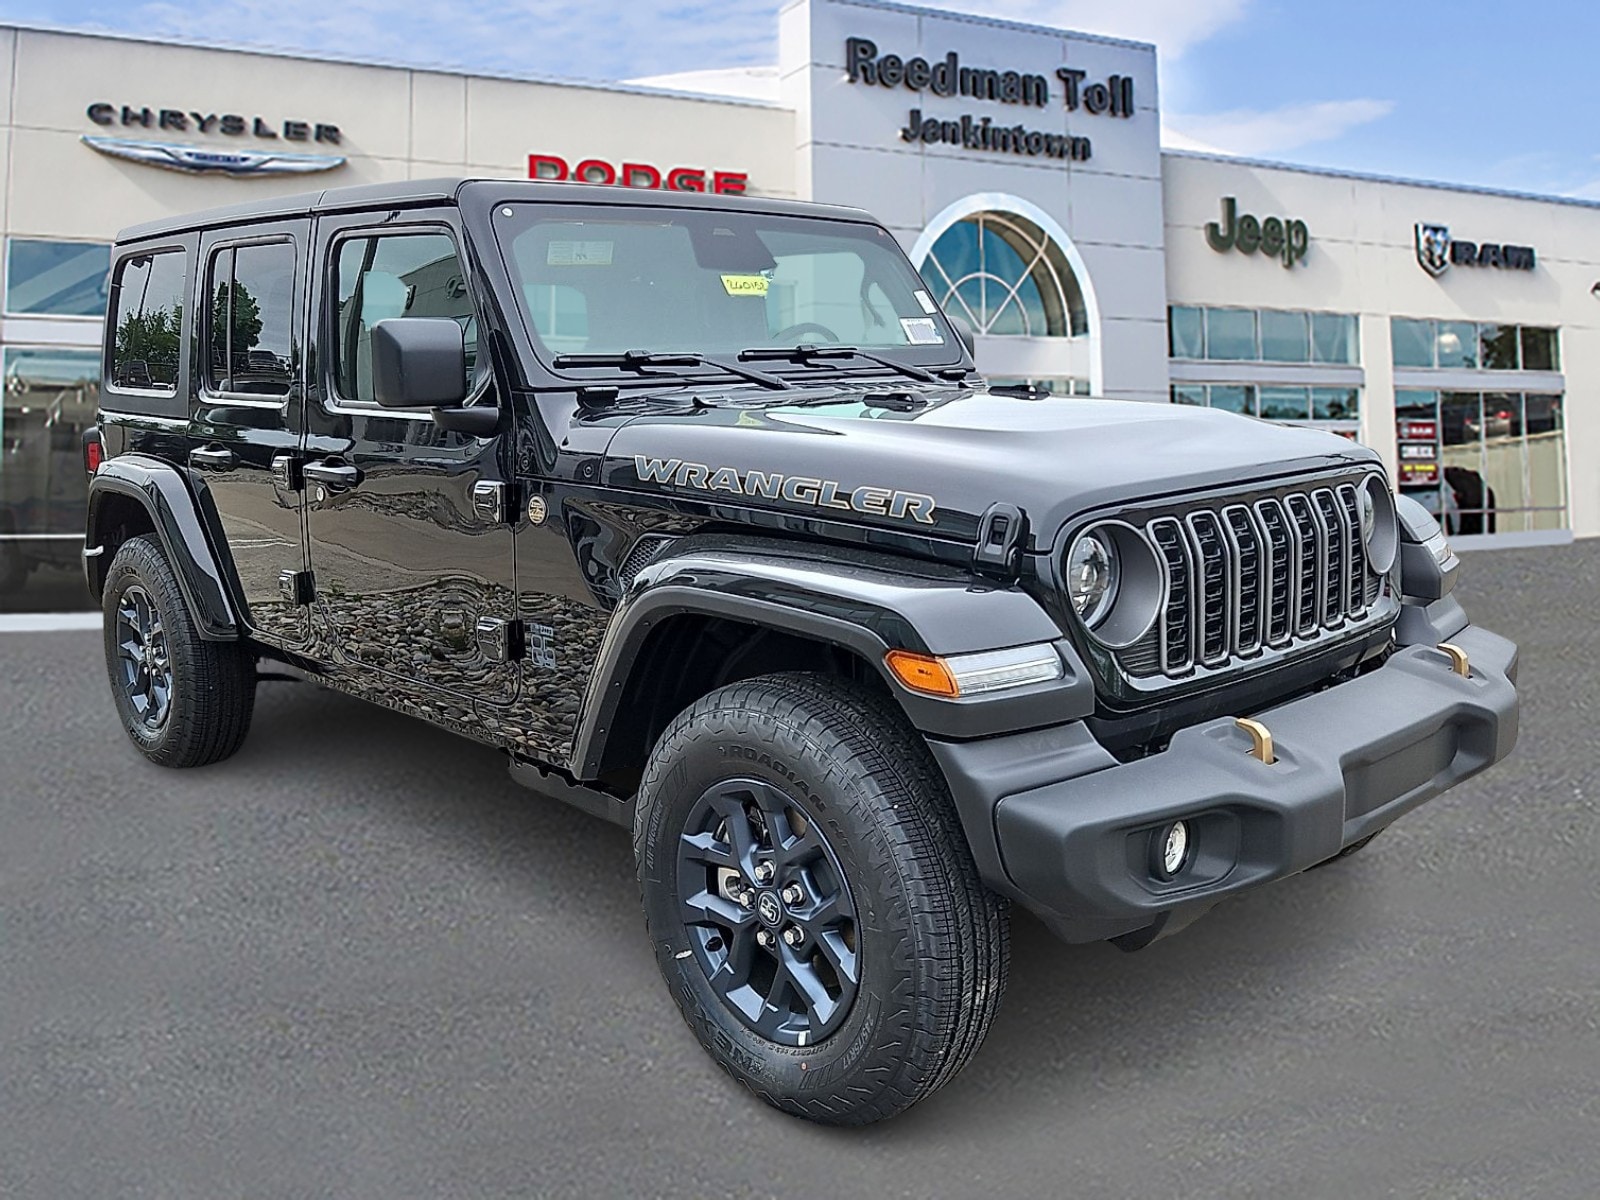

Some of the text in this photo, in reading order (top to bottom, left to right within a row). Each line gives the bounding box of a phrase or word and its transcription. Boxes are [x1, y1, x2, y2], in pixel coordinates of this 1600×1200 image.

[846, 37, 1134, 119] Reedman Toll
[87, 102, 342, 145] CHRYSLER
[901, 109, 1092, 161] Jenkintown
[528, 154, 748, 196] DODGE
[1205, 197, 1309, 269] Jeep
[1450, 241, 1536, 270] RAM
[634, 454, 936, 525] WRANGLER
[728, 744, 827, 814] ROADIAN
[646, 798, 664, 871] All-Weather
